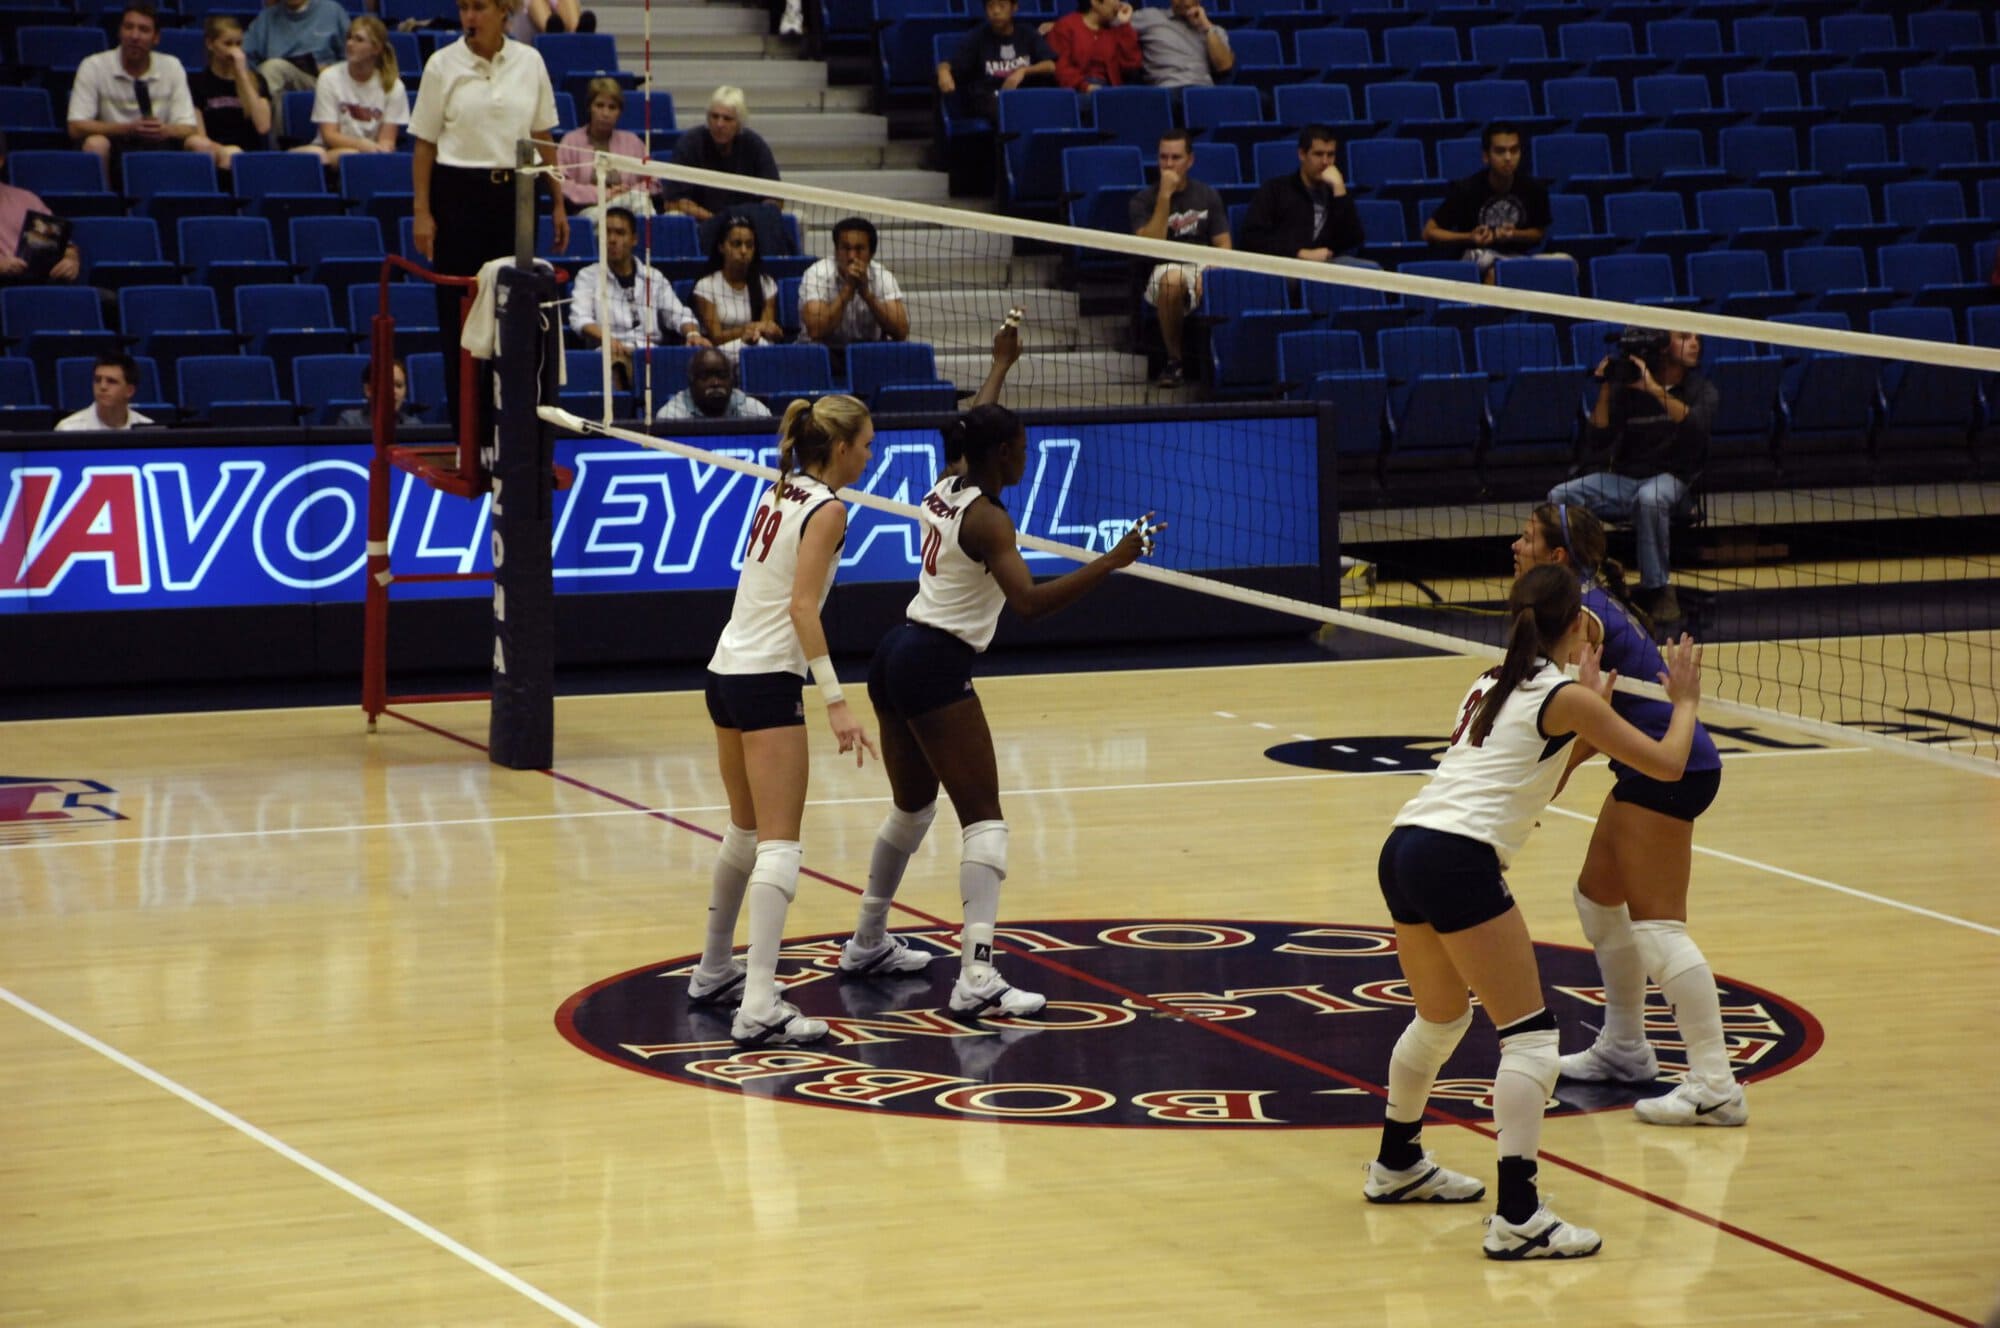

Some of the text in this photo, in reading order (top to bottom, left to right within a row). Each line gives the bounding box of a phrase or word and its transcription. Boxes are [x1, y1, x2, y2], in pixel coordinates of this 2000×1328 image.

[985, 55, 1029, 75] ARIZON
[747, 504, 783, 563] 99
[618, 1039, 1291, 1123] BOBBI
